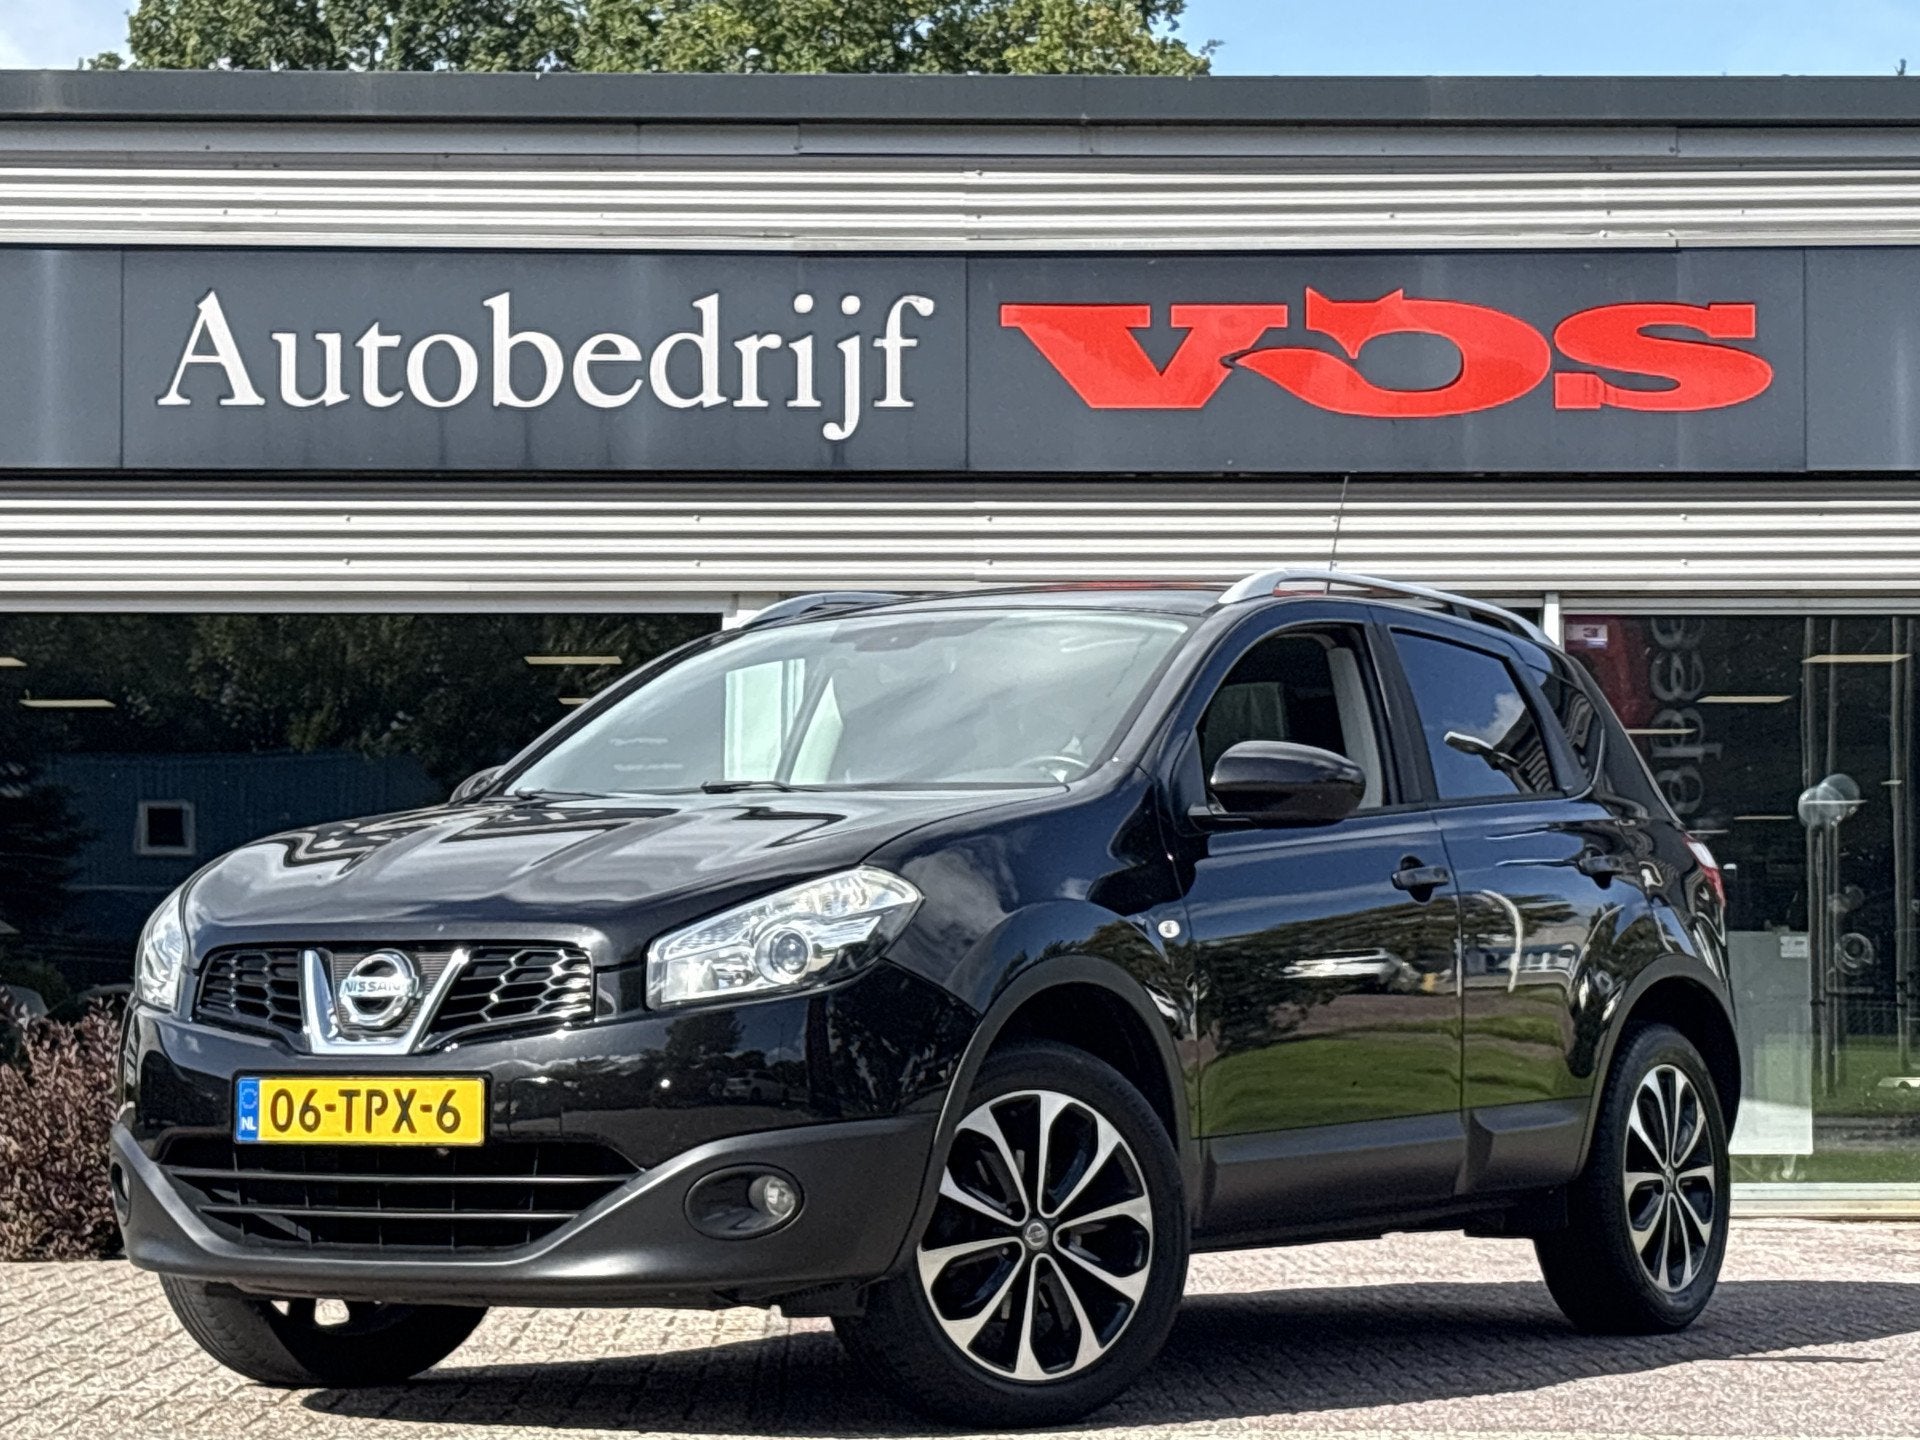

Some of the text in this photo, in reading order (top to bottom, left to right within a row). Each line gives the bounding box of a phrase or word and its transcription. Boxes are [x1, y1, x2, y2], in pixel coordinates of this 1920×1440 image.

[157, 290, 936, 442] Autobedrijf
[241, 1116, 257, 1131] NL
[270, 1088, 462, 1134] 06-TPX-6
